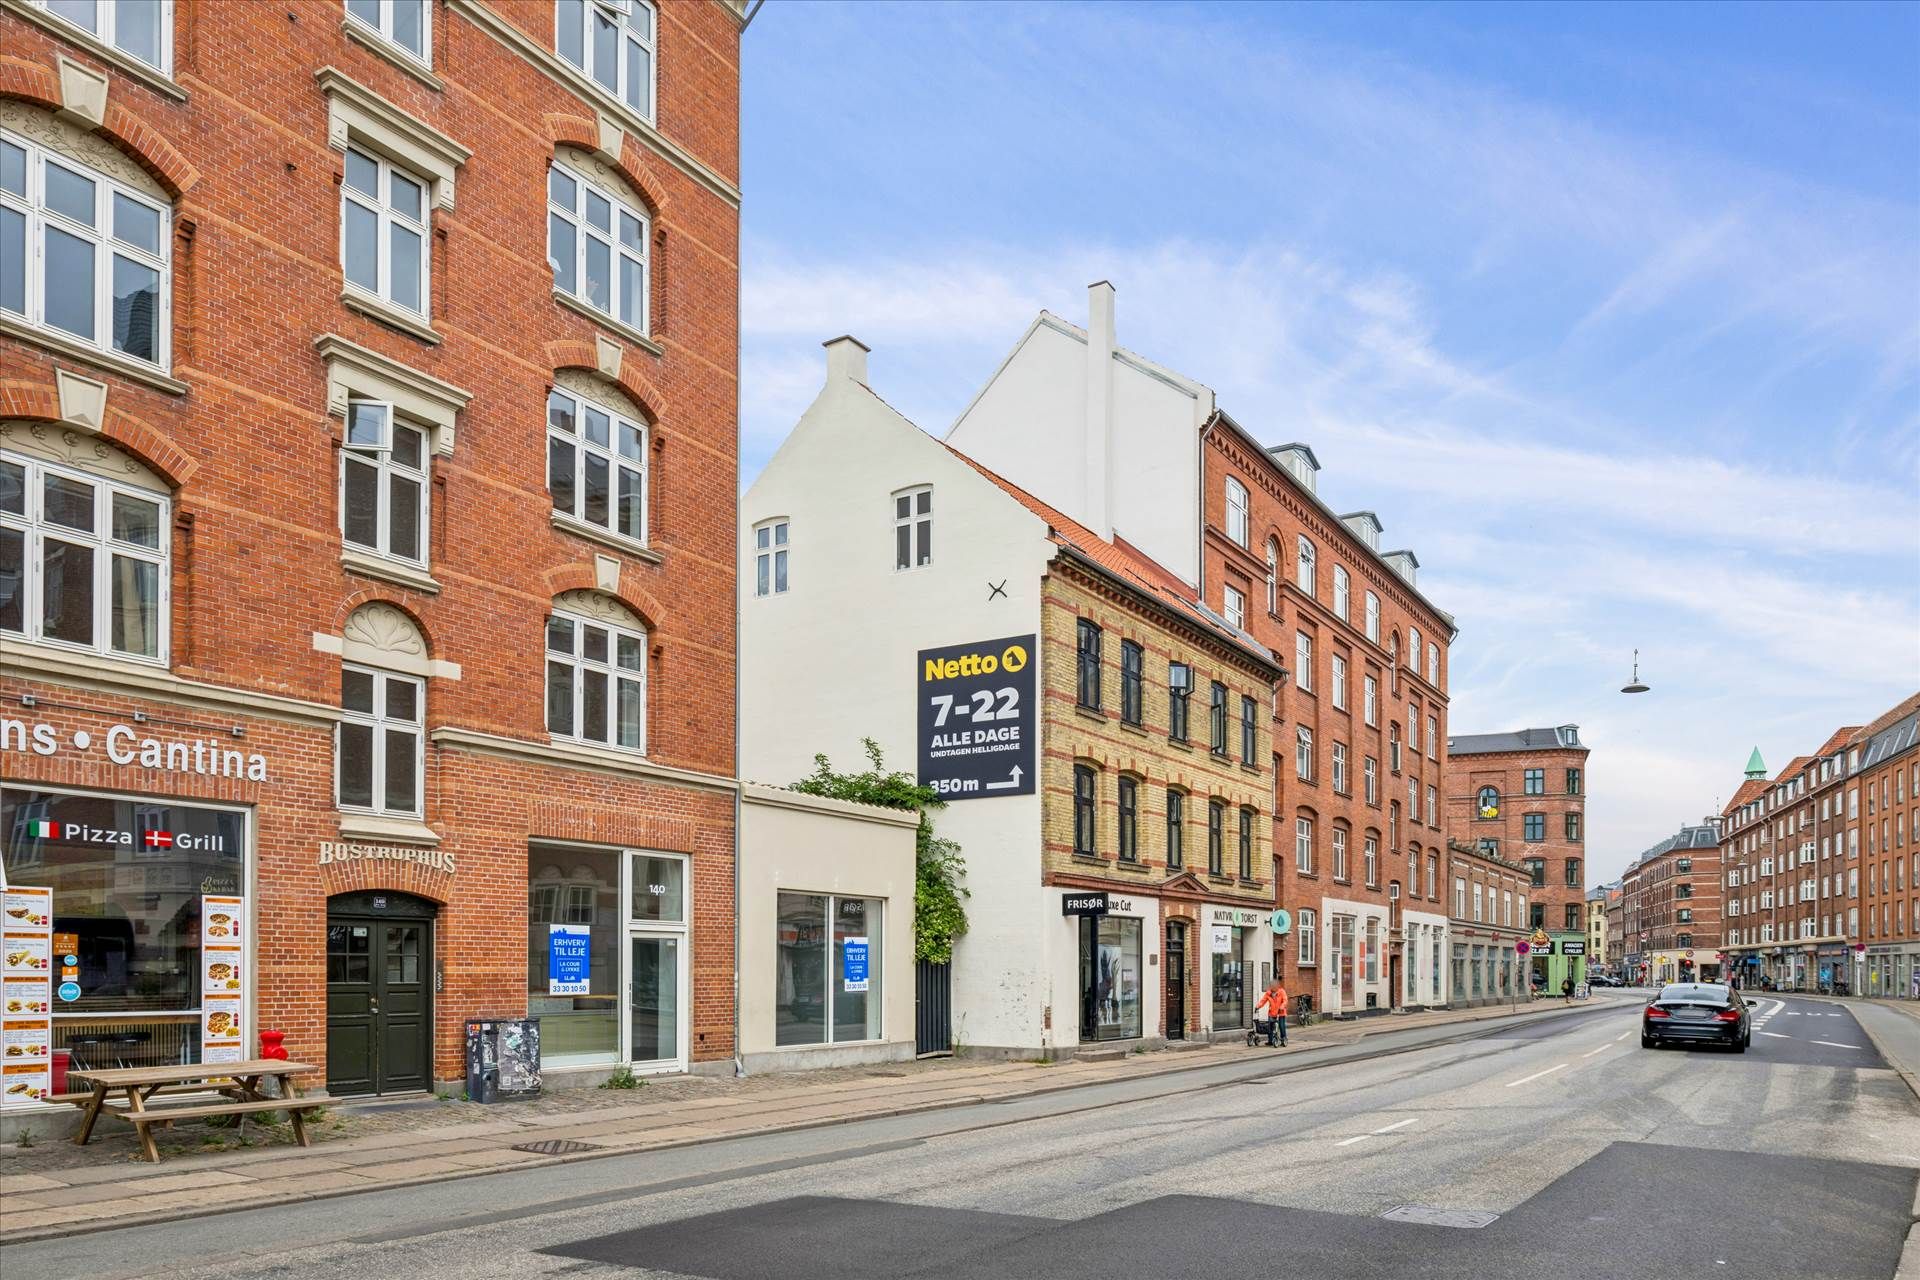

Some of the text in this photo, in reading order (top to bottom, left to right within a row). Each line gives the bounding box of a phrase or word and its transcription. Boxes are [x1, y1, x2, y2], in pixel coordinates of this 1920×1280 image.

[925, 654, 998, 681] Netto
[931, 687, 1020, 727] 7-22
[931, 727, 1020, 748] ALLE DAGE
[106, 724, 267, 782] Cantina
[930, 743, 1020, 758] UNDTAGEN HELLIGDAGE
[65, 823, 133, 845] Pizza
[176, 833, 223, 852] Grill
[319, 841, 456, 874] BOSTRUPHUS
[649, 884, 666, 896] 140
[1067, 898, 1103, 909] FRISØR
[1120, 900, 1131, 911] Cut
[554, 938, 586, 947] ERHVERV
[554, 947, 585, 956] TIL LEJE
